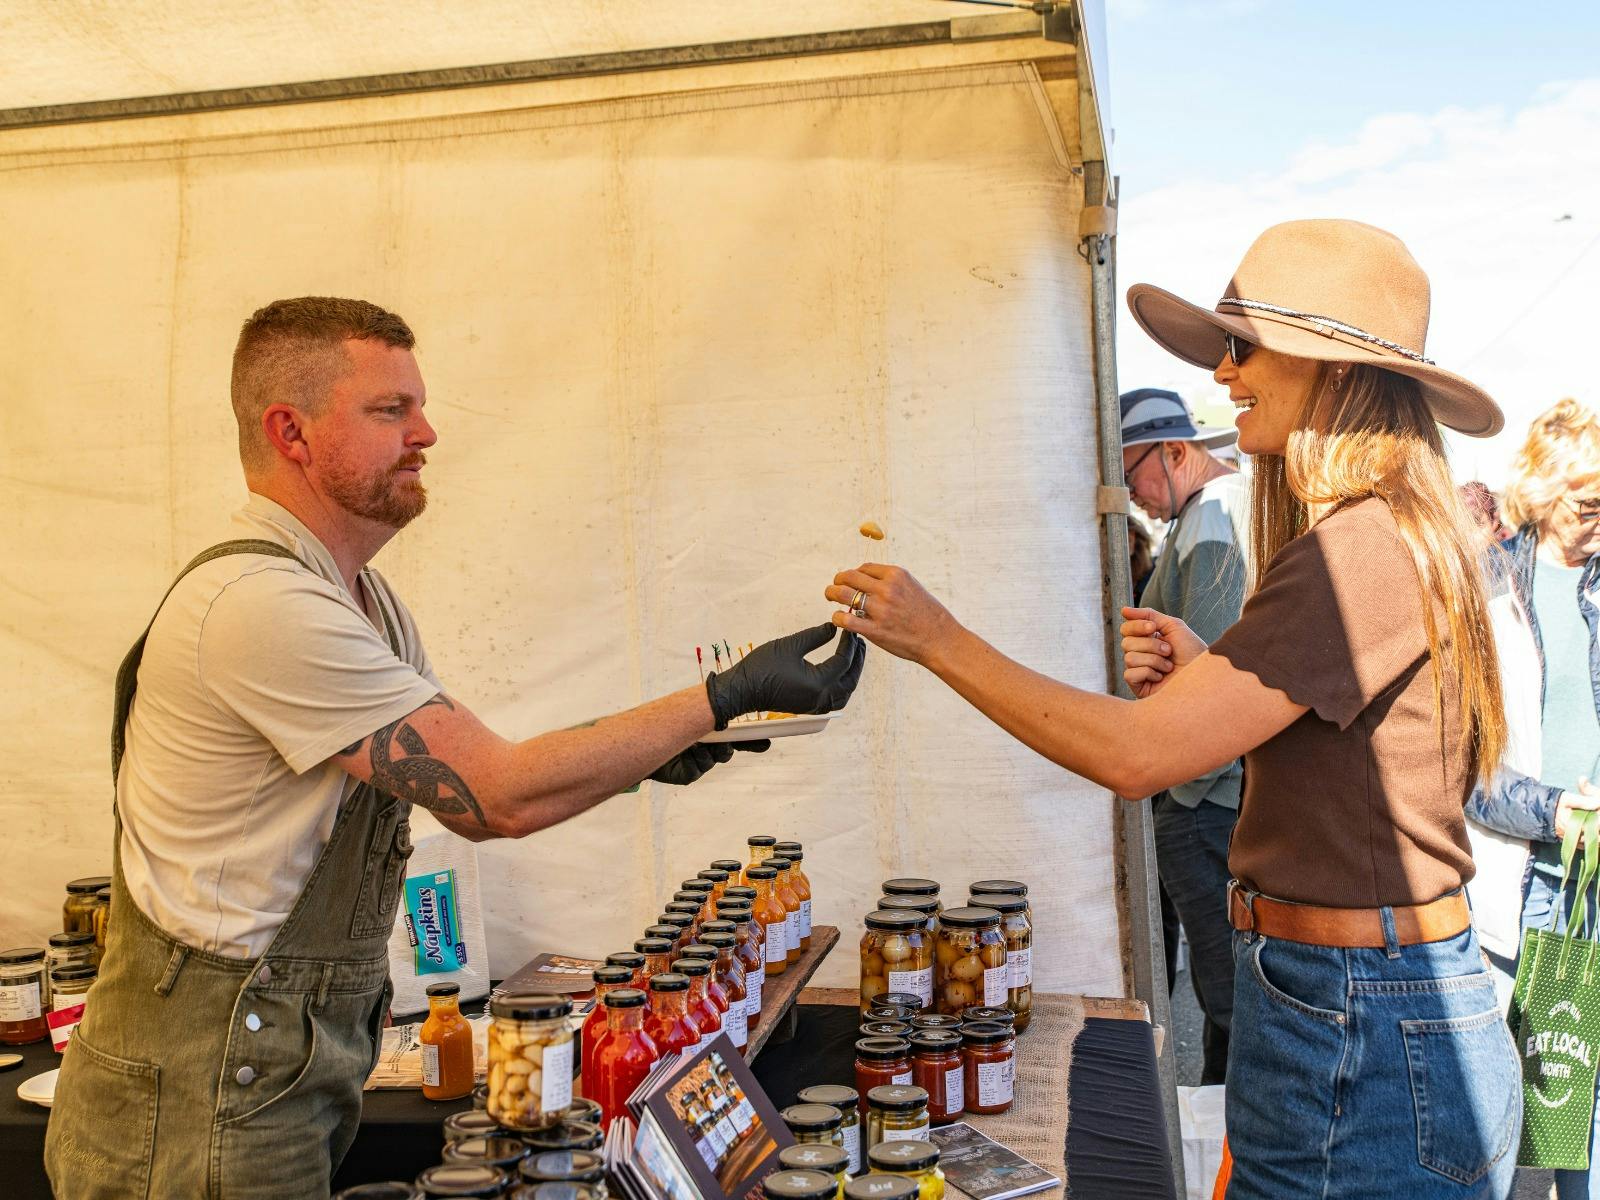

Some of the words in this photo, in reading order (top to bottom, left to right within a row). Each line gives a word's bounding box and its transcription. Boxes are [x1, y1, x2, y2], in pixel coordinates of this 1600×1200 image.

[417, 887, 444, 964] Napkins
[1526, 1030, 1552, 1058] EAT
[1552, 1031, 1591, 1068] LOCAL
[1540, 1061, 1571, 1079] MONTH
